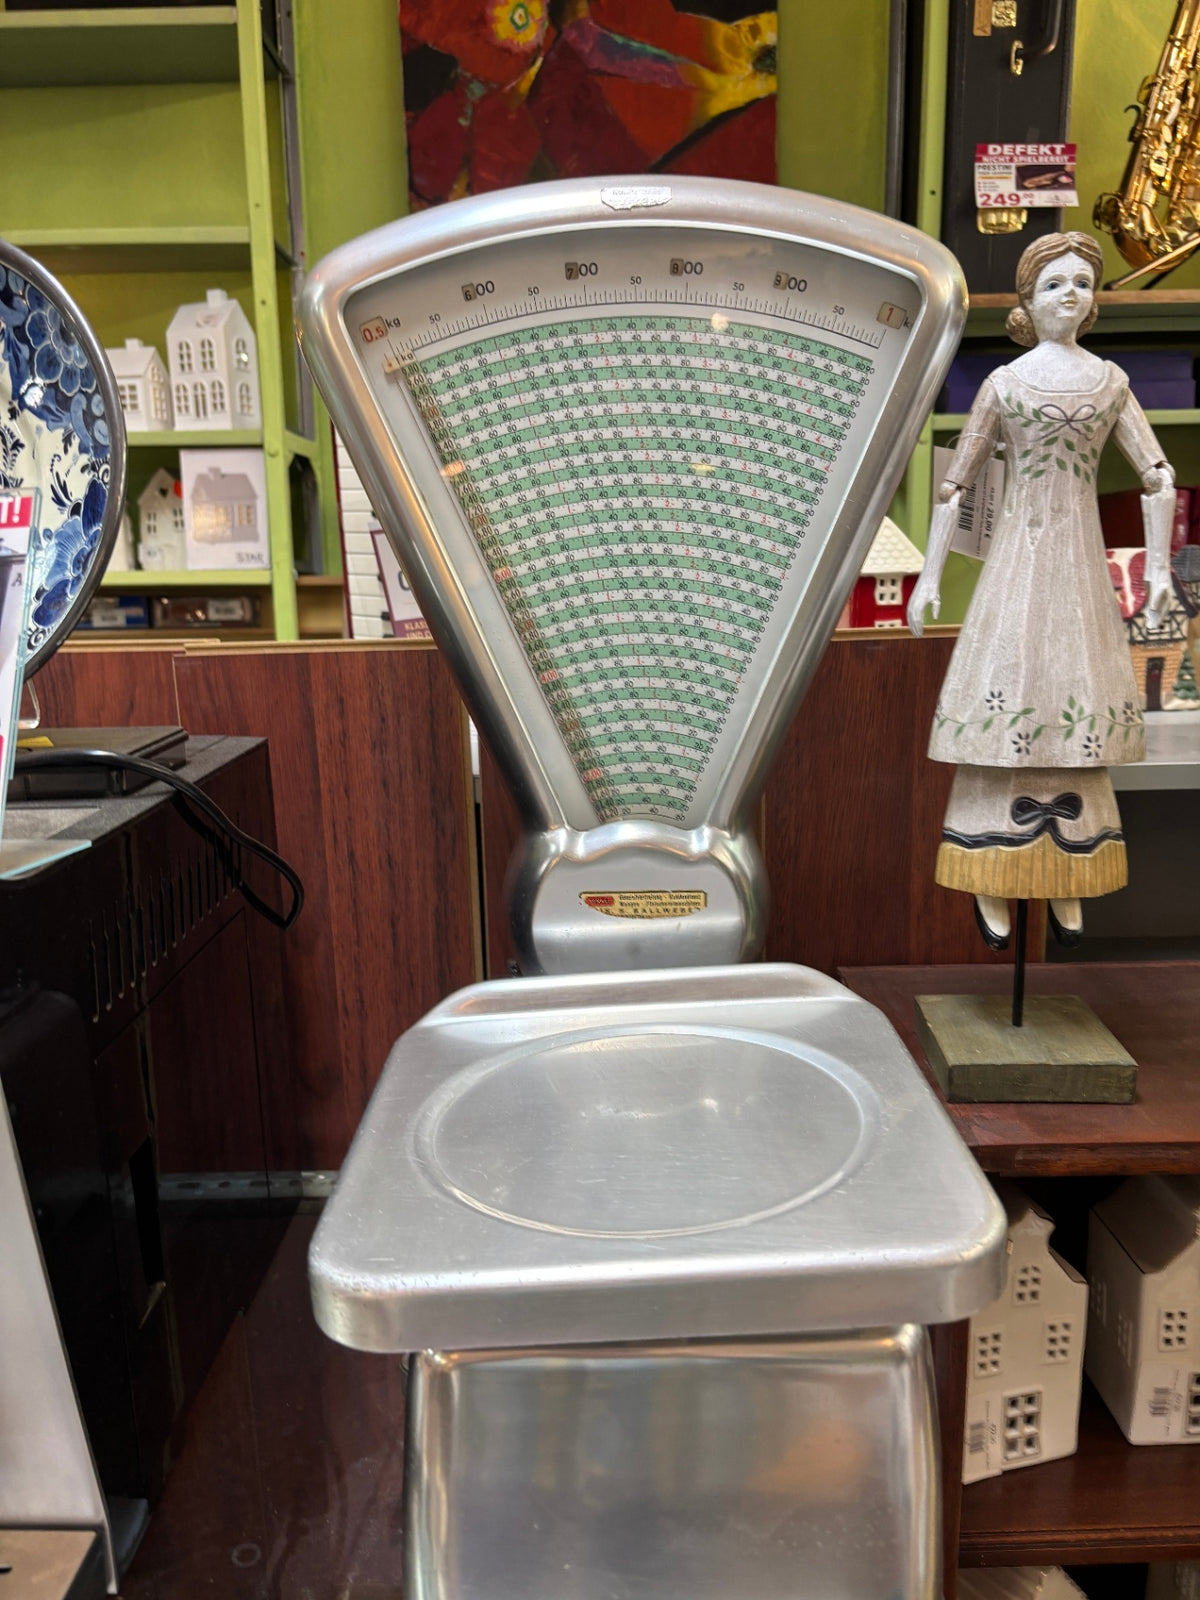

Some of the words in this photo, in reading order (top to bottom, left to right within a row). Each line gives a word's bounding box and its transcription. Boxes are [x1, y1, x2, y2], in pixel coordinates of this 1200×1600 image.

[987, 144, 1066, 155] DEFEKT
[979, 193, 1021, 207] 249
[429, 313, 441, 324] 50
[463, 281, 495, 300] 600
[527, 286, 540, 296] 50
[566, 262, 598, 280] 700
[630, 276, 642, 285] 50
[671, 261, 704, 275] 800
[732, 281, 745, 292] 50
[774, 274, 808, 293] 900
[832, 305, 845, 316] 50
[385, 318, 401, 330] kg
